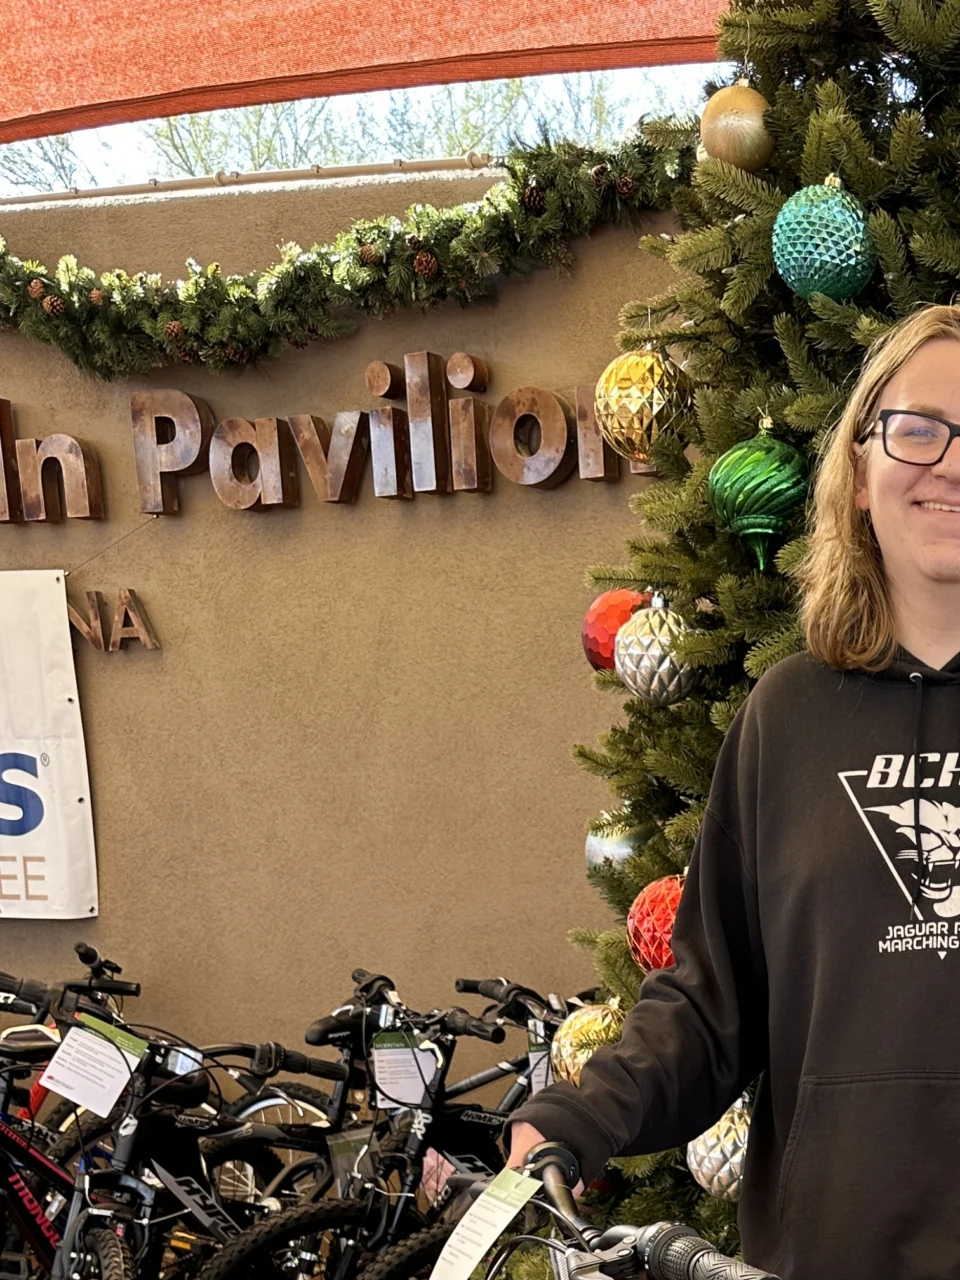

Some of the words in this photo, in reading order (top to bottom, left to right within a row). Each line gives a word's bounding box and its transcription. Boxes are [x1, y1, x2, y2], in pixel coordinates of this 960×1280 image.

[885, 921, 949, 940] JAGUAR
[878, 935, 960, 953] MARCHING
[175, 1176, 243, 1241] HYPE
